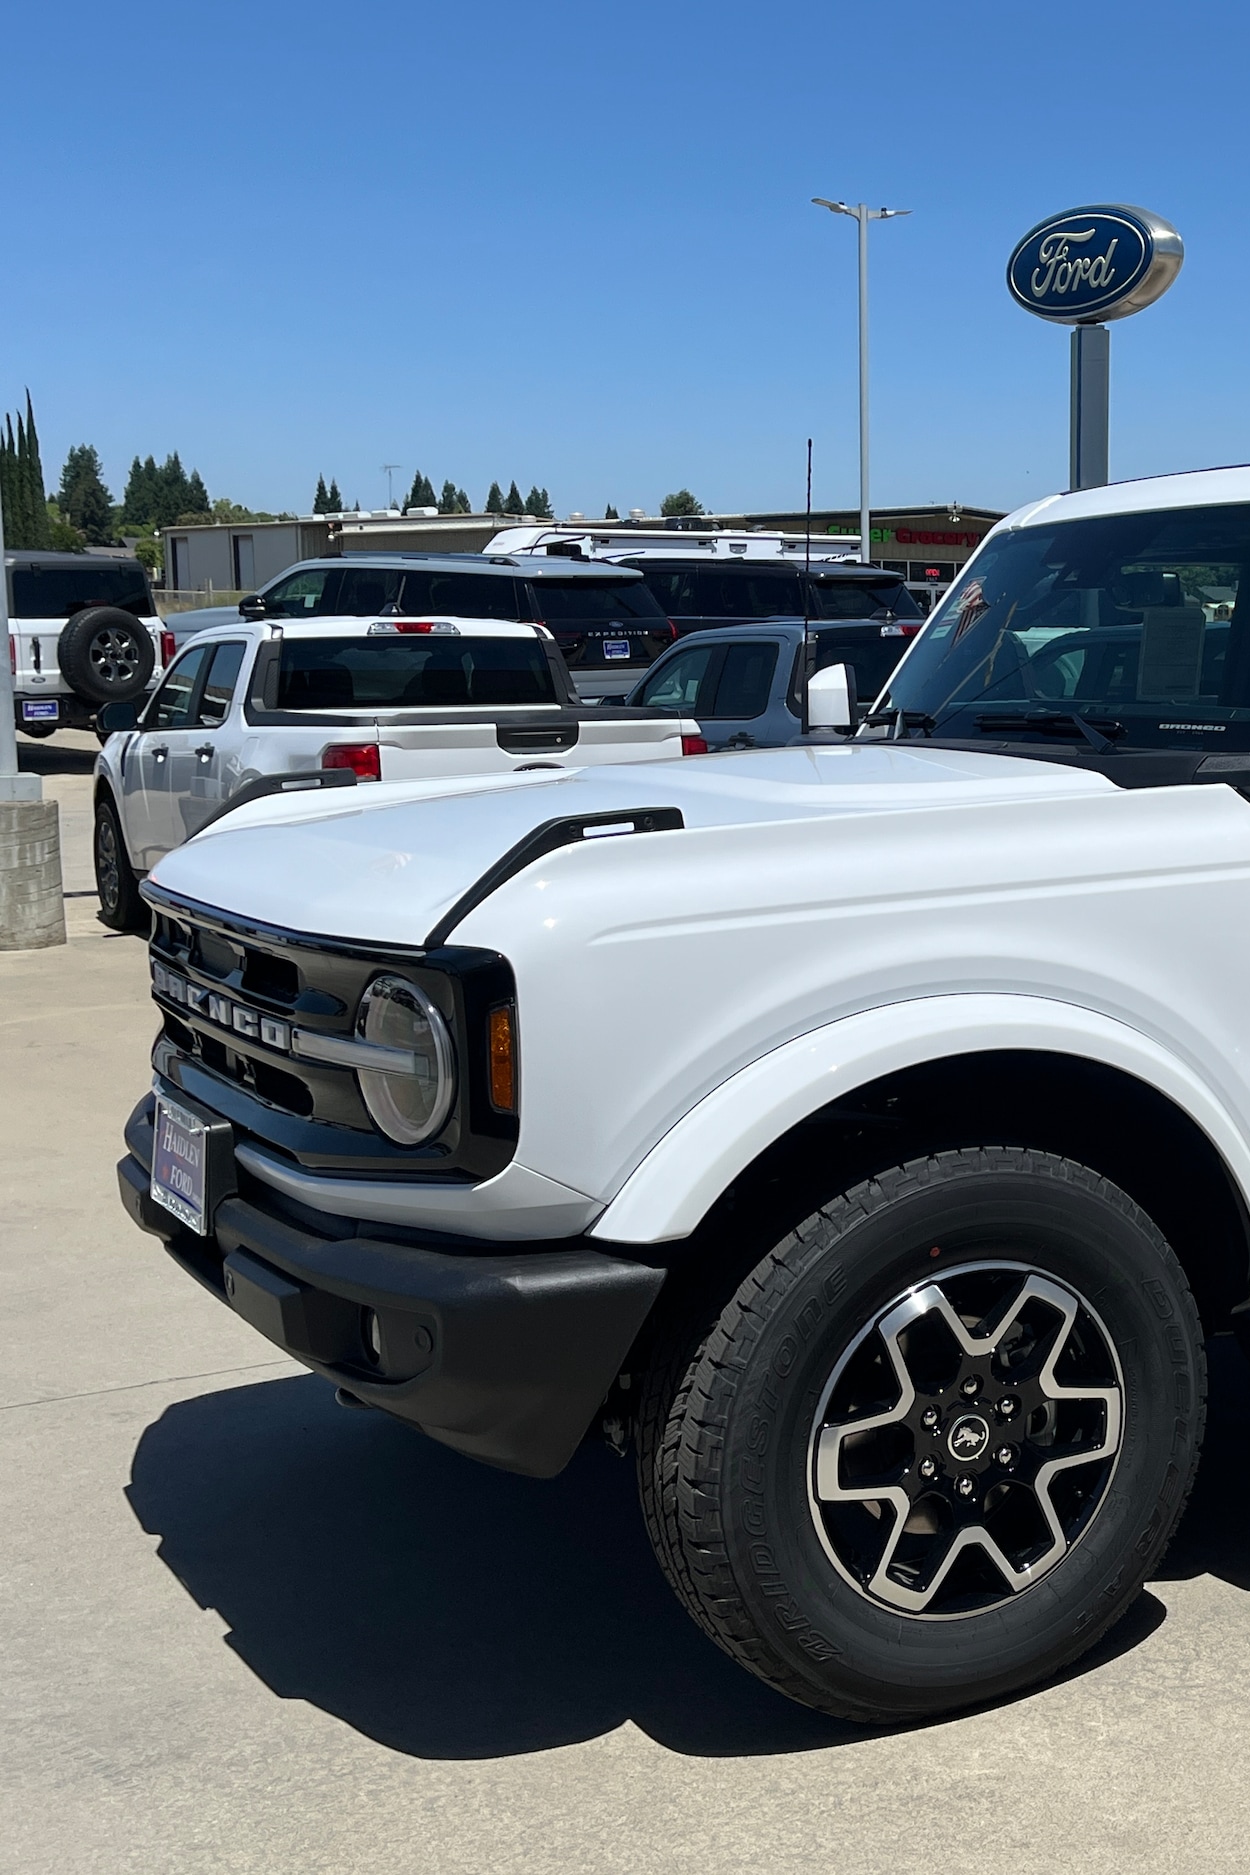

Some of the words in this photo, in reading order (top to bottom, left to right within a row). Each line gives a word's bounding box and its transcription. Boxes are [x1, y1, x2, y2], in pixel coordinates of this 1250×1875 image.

[1030, 227, 1119, 298] Ford
[895, 528, 979, 547] Grocery
[1158, 723, 1227, 732] BRONCO
[170, 1164, 193, 1197] FORD
[1135, 1273, 1193, 1561] DUELER
[738, 1262, 849, 1664] BRIDGESTONE
